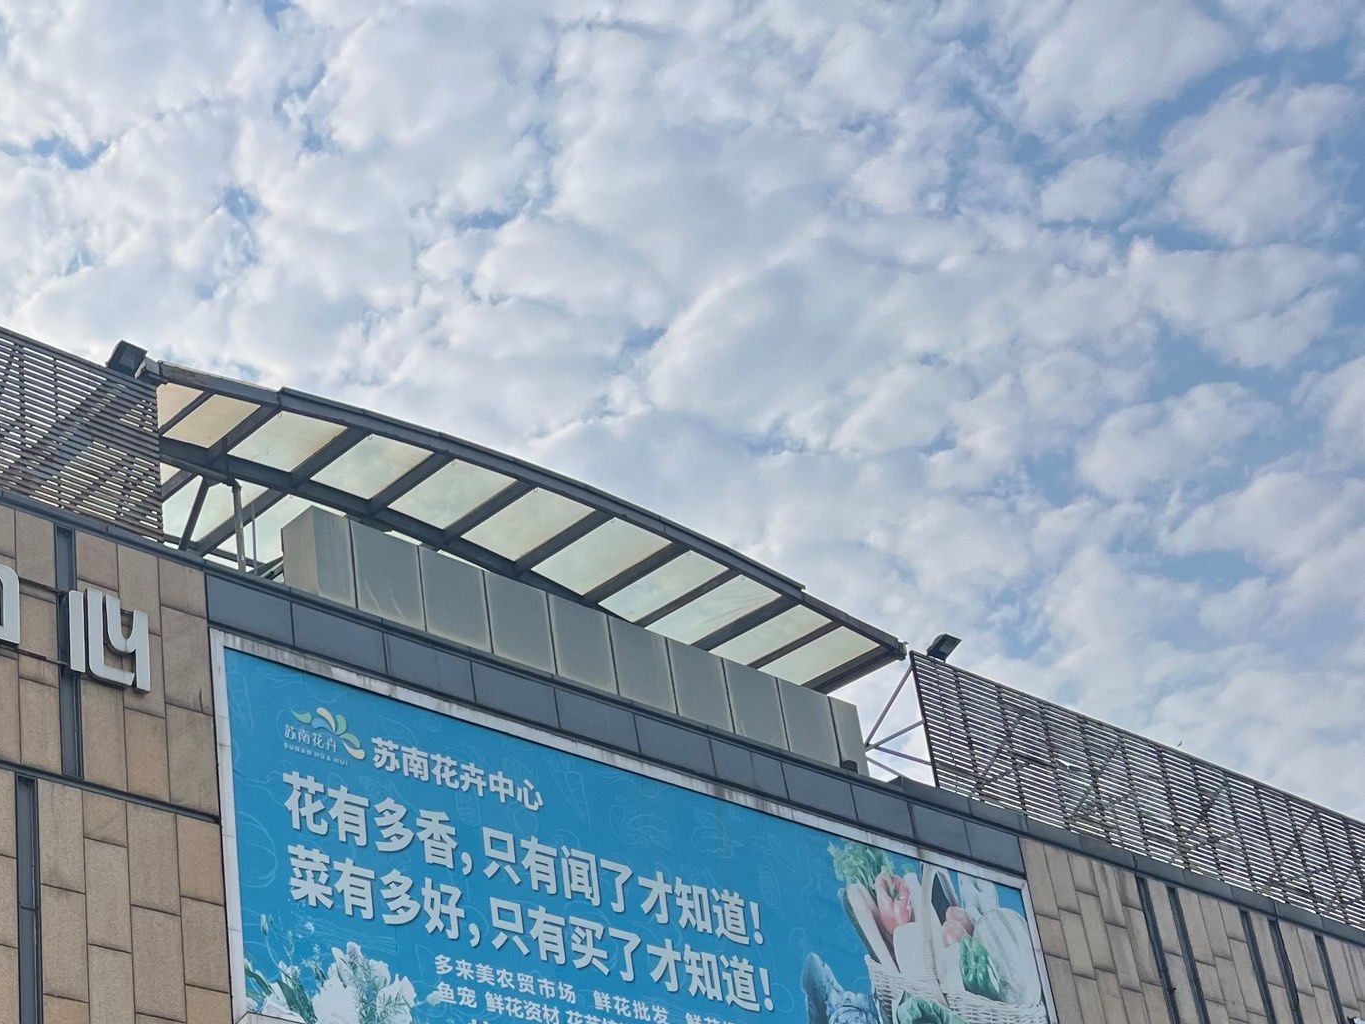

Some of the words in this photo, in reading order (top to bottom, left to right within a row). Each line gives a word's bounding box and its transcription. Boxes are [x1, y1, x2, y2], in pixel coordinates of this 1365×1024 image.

[284, 724, 337, 752] 苏南花卉
[371, 736, 545, 811] 苏南花卉中心
[282, 770, 764, 945] 花有多香，只有闻了才知道！
[287, 843, 775, 1012] 菜有多好，只有买了才知道！
[435, 954, 576, 1005] 多来美农贸市场
[436, 981, 477, 1009] 鱼宠
